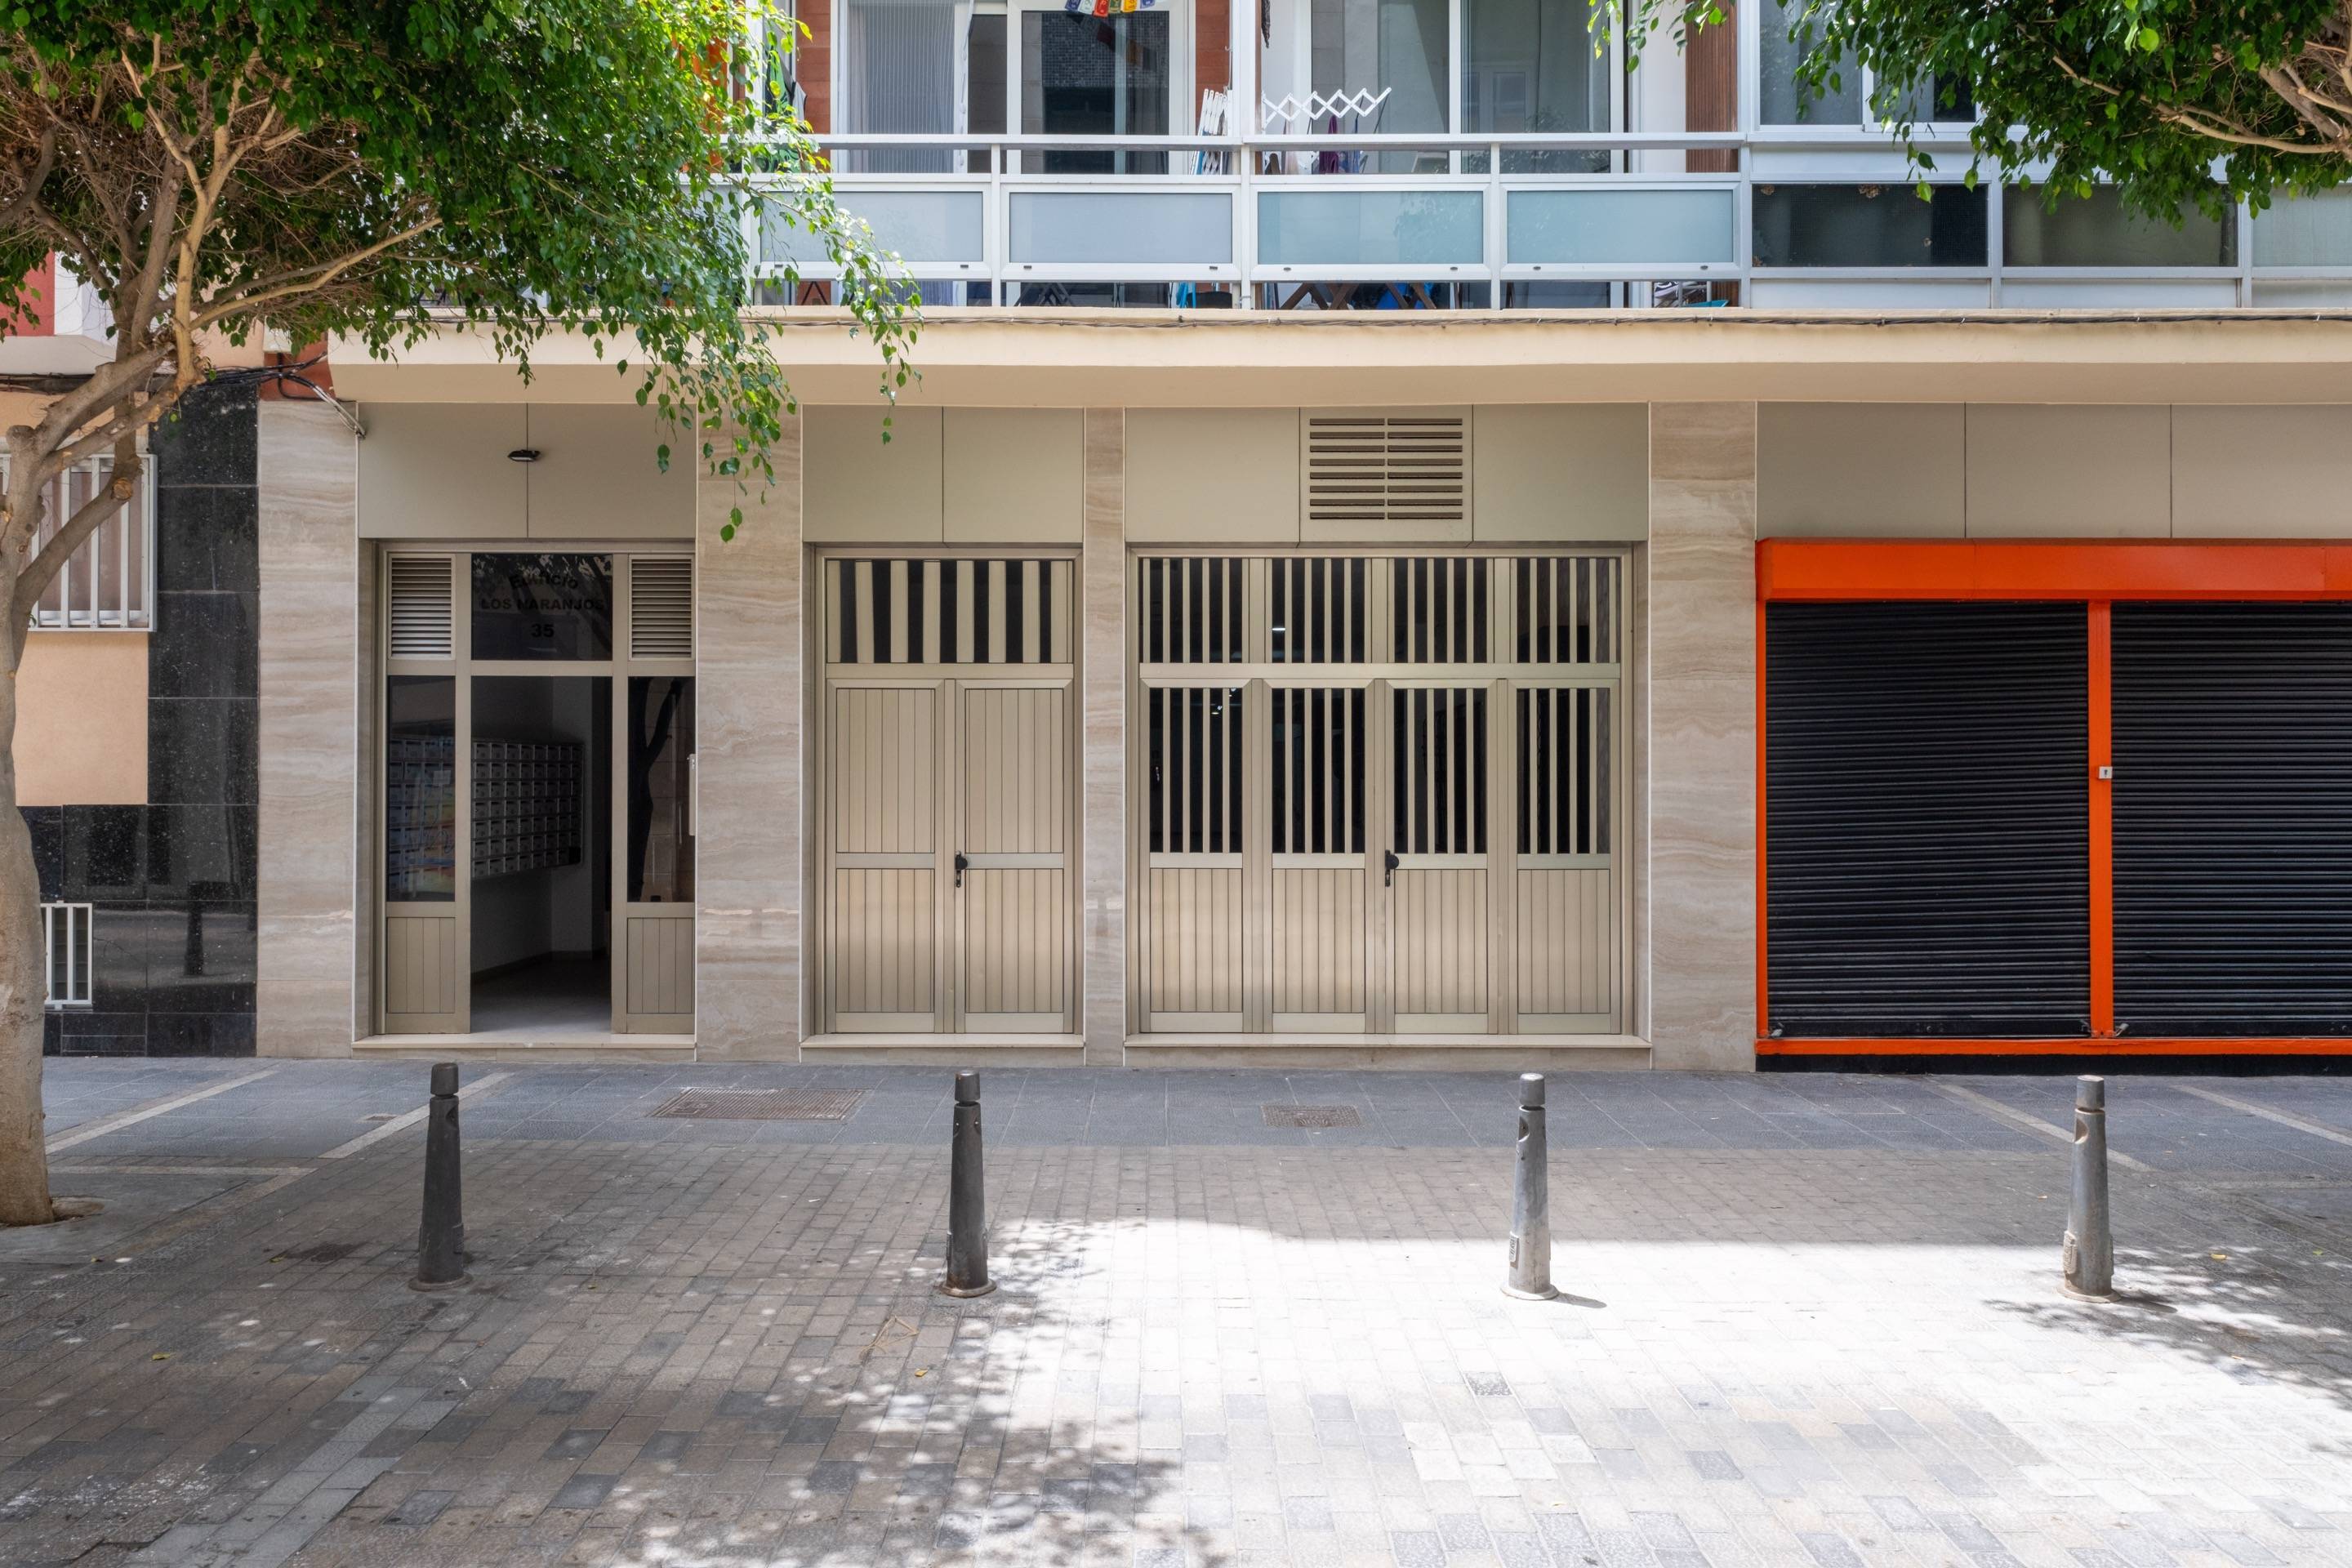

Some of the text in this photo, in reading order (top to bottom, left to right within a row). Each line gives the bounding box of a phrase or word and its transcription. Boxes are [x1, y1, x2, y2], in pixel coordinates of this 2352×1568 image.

[481, 599, 604, 610] LOS NARANJOS
[530, 623, 555, 638] 35
